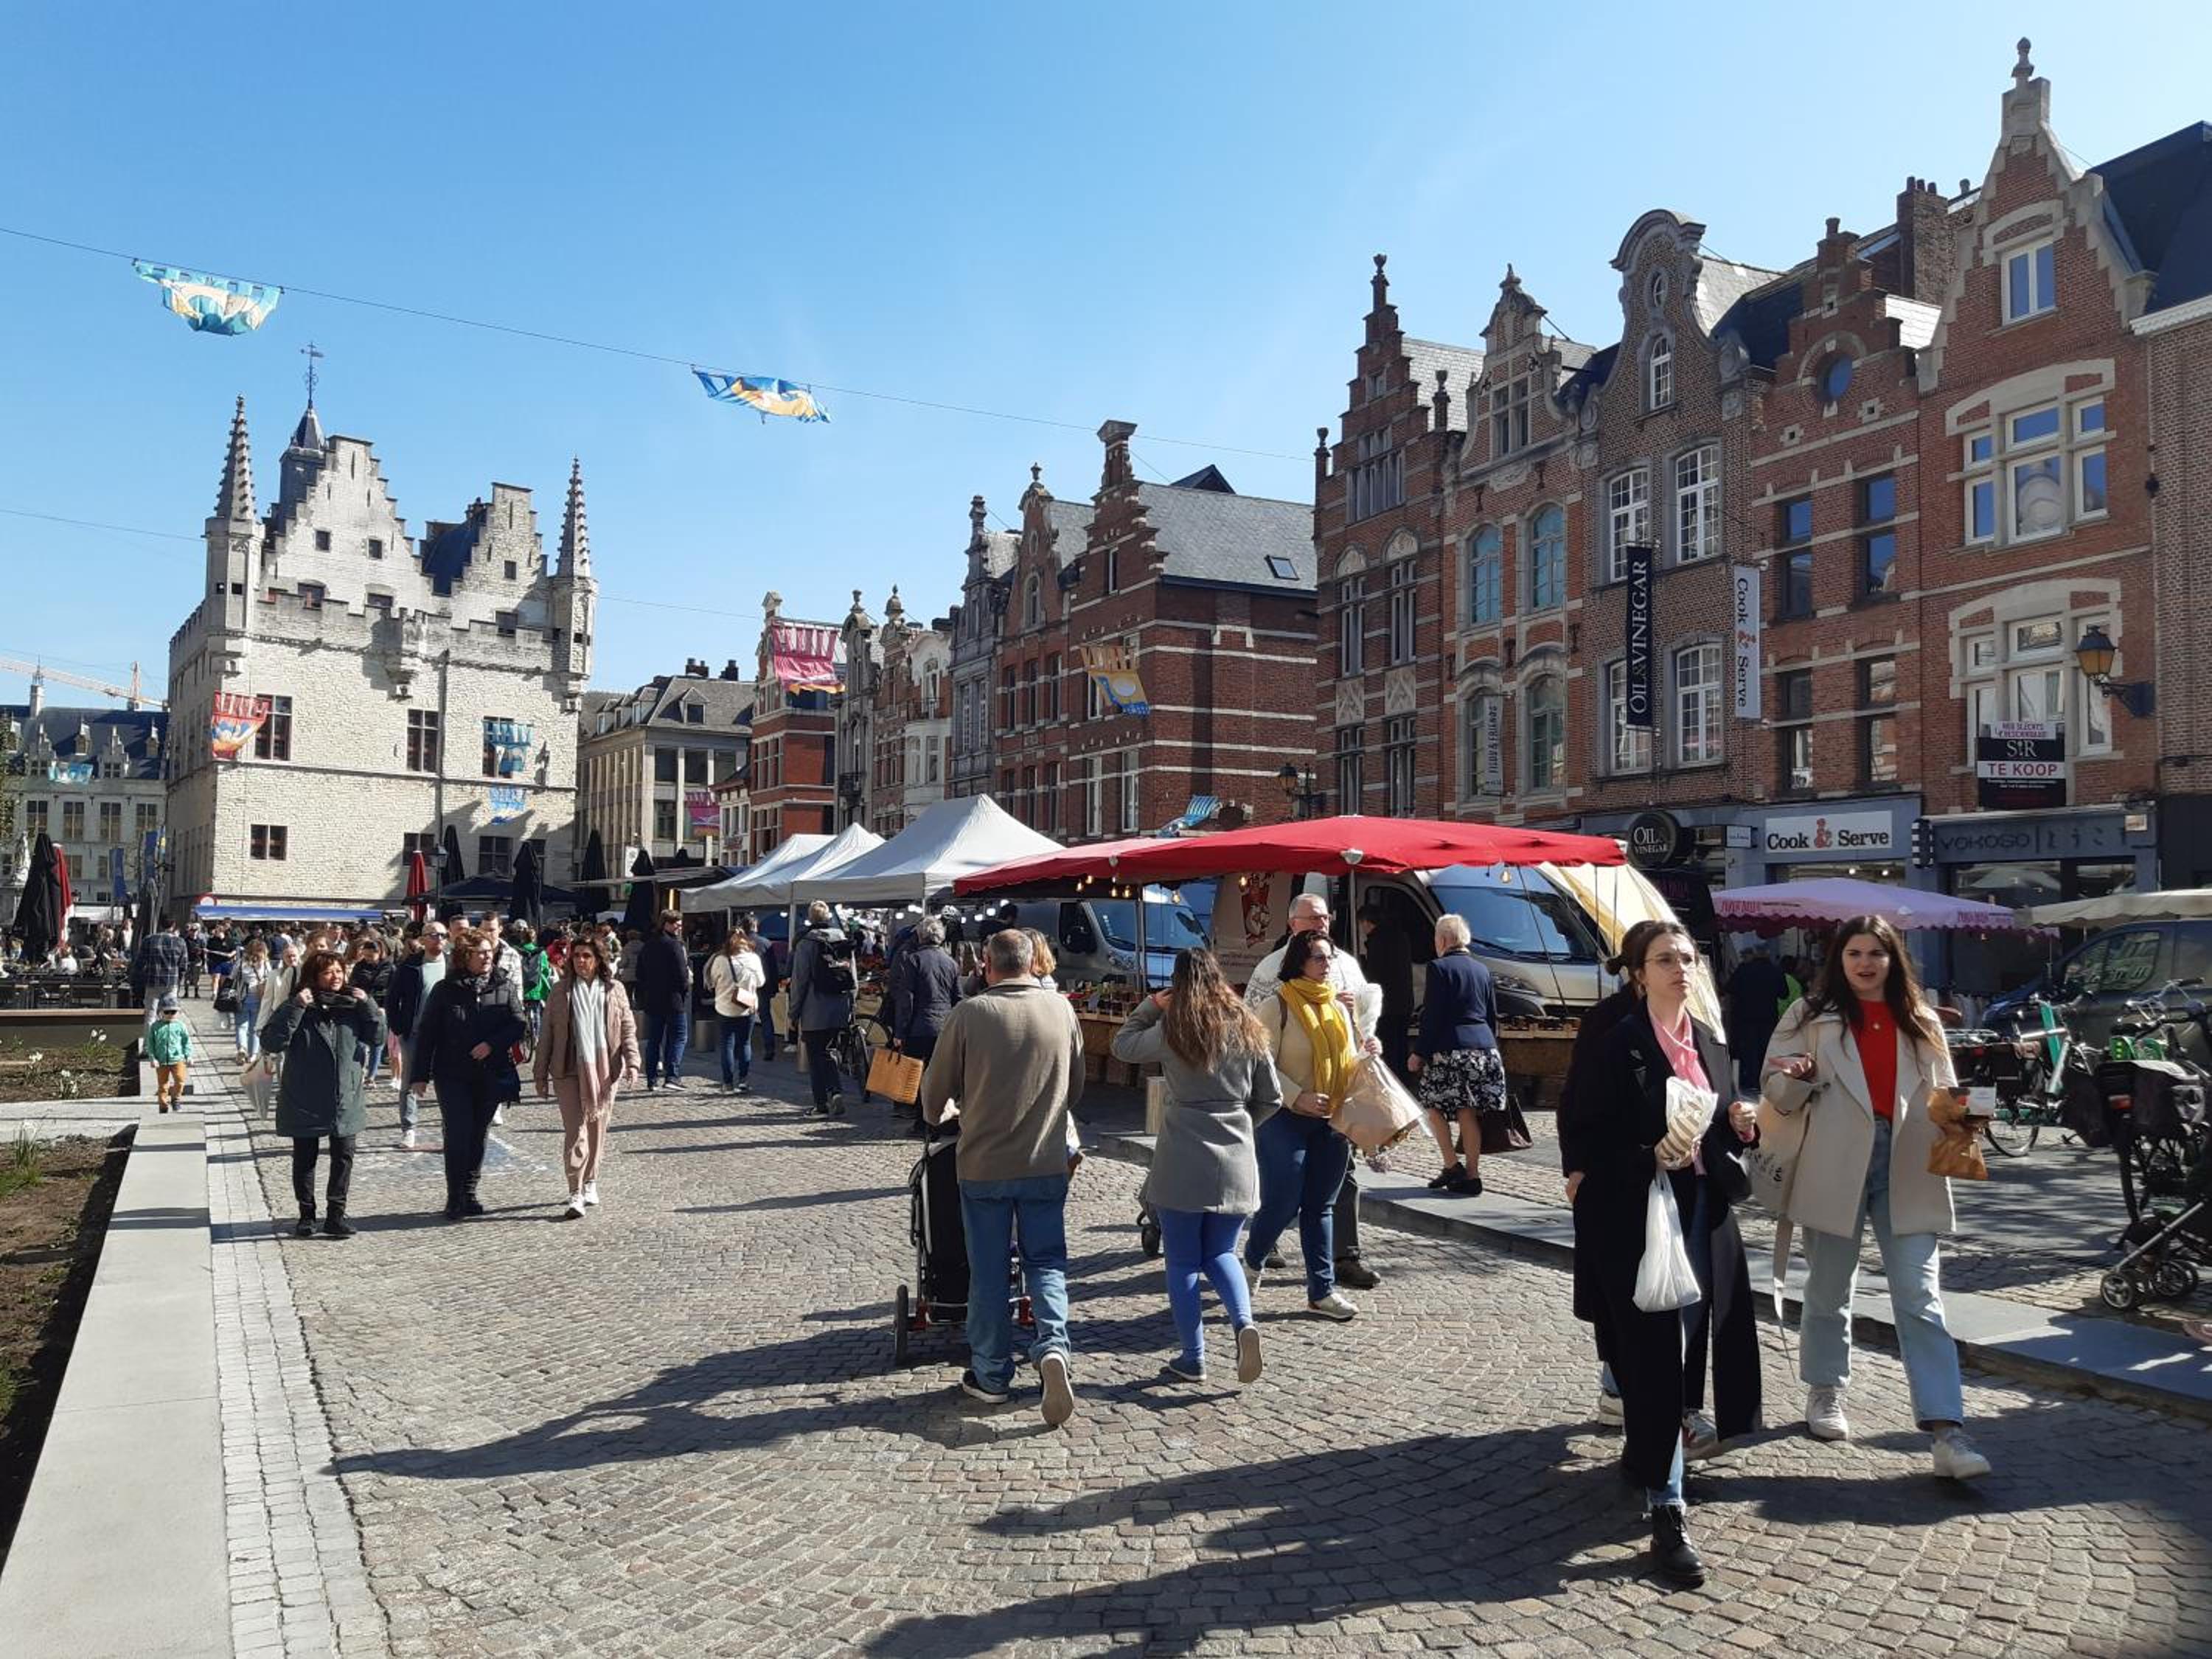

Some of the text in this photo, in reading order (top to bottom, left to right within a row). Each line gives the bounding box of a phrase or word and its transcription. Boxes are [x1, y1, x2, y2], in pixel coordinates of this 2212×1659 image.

[1736, 577, 1749, 622] Cook
[1737, 656, 1750, 707] Serve
[1987, 763, 2058, 776] TE KOOP
[1767, 833, 1810, 849] Cook
[1837, 830, 1889, 846] Serve
